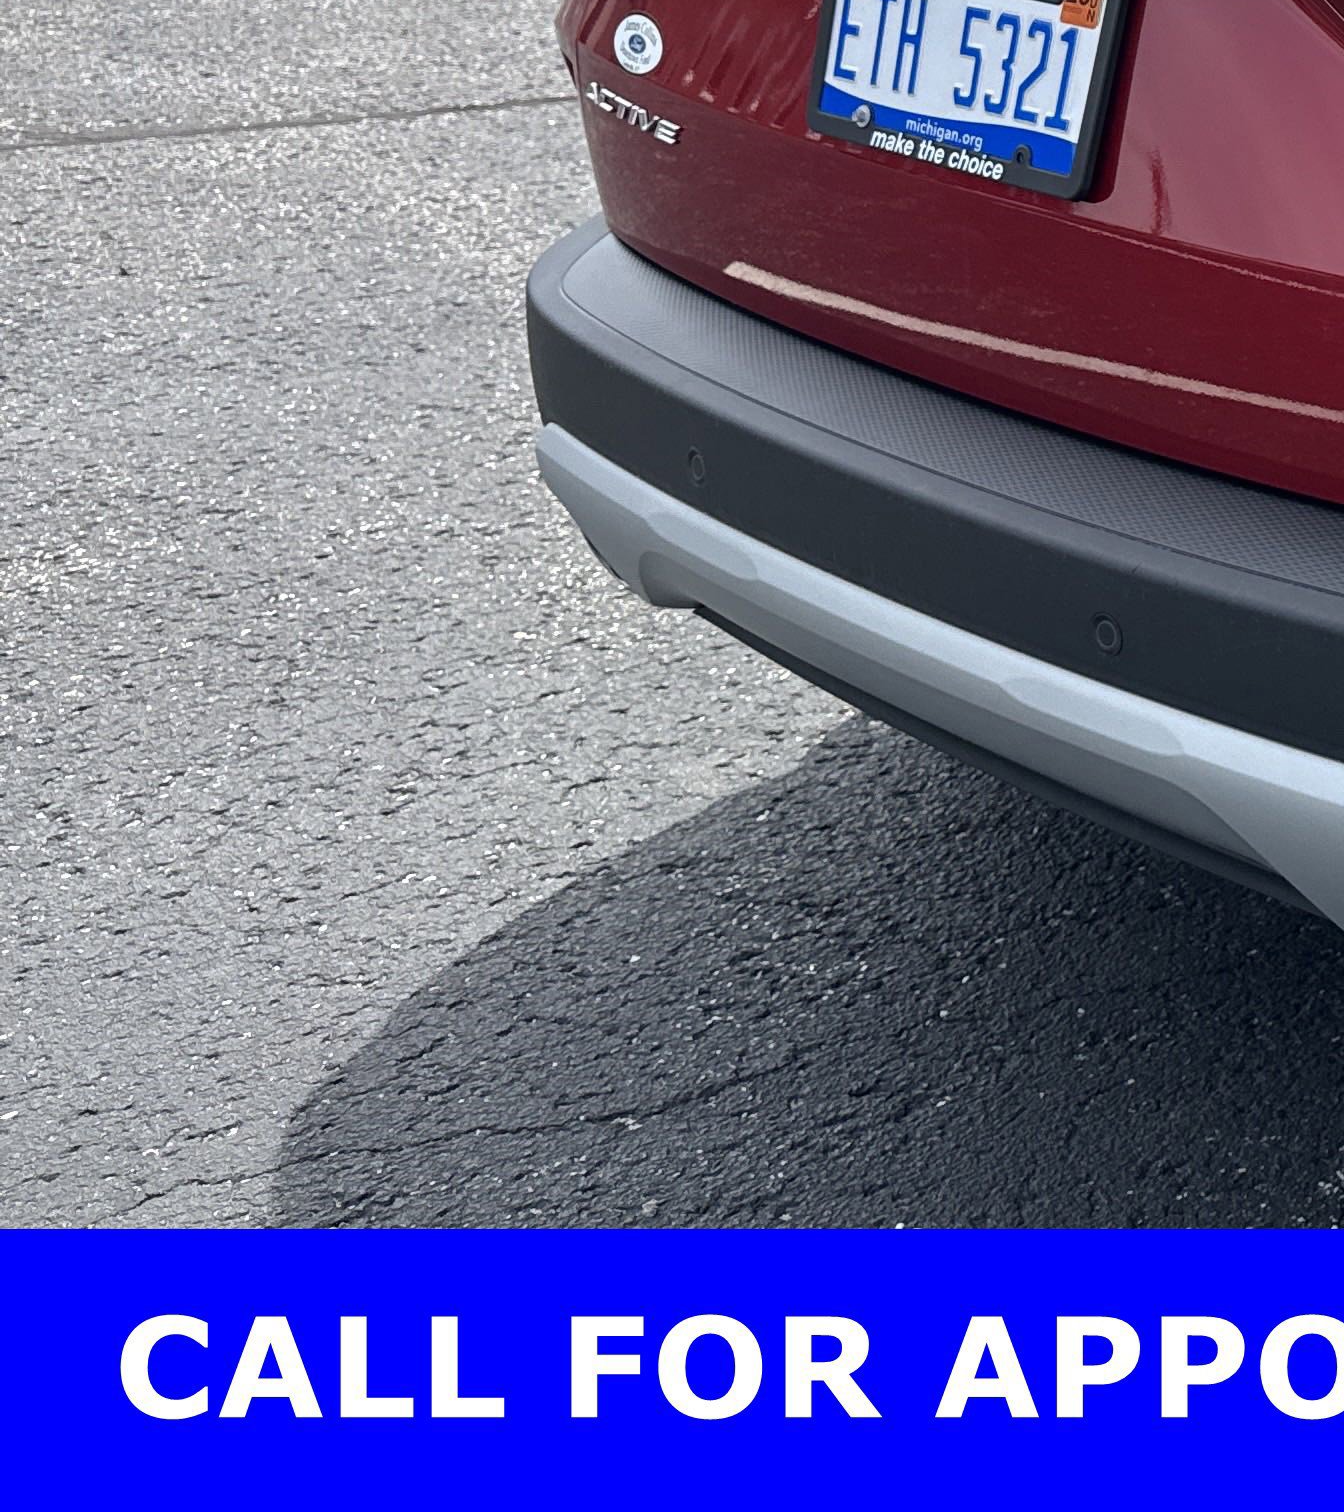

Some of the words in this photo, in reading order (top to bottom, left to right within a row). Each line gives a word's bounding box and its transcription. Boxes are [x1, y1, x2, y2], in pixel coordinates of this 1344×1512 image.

[952, 6, 1080, 131] 5321
[586, 81, 681, 145] ACTIVE
[905, 117, 984, 152] michigan.org
[869, 130, 915, 156] make
[917, 139, 945, 165] the
[948, 148, 1004, 180] choice
